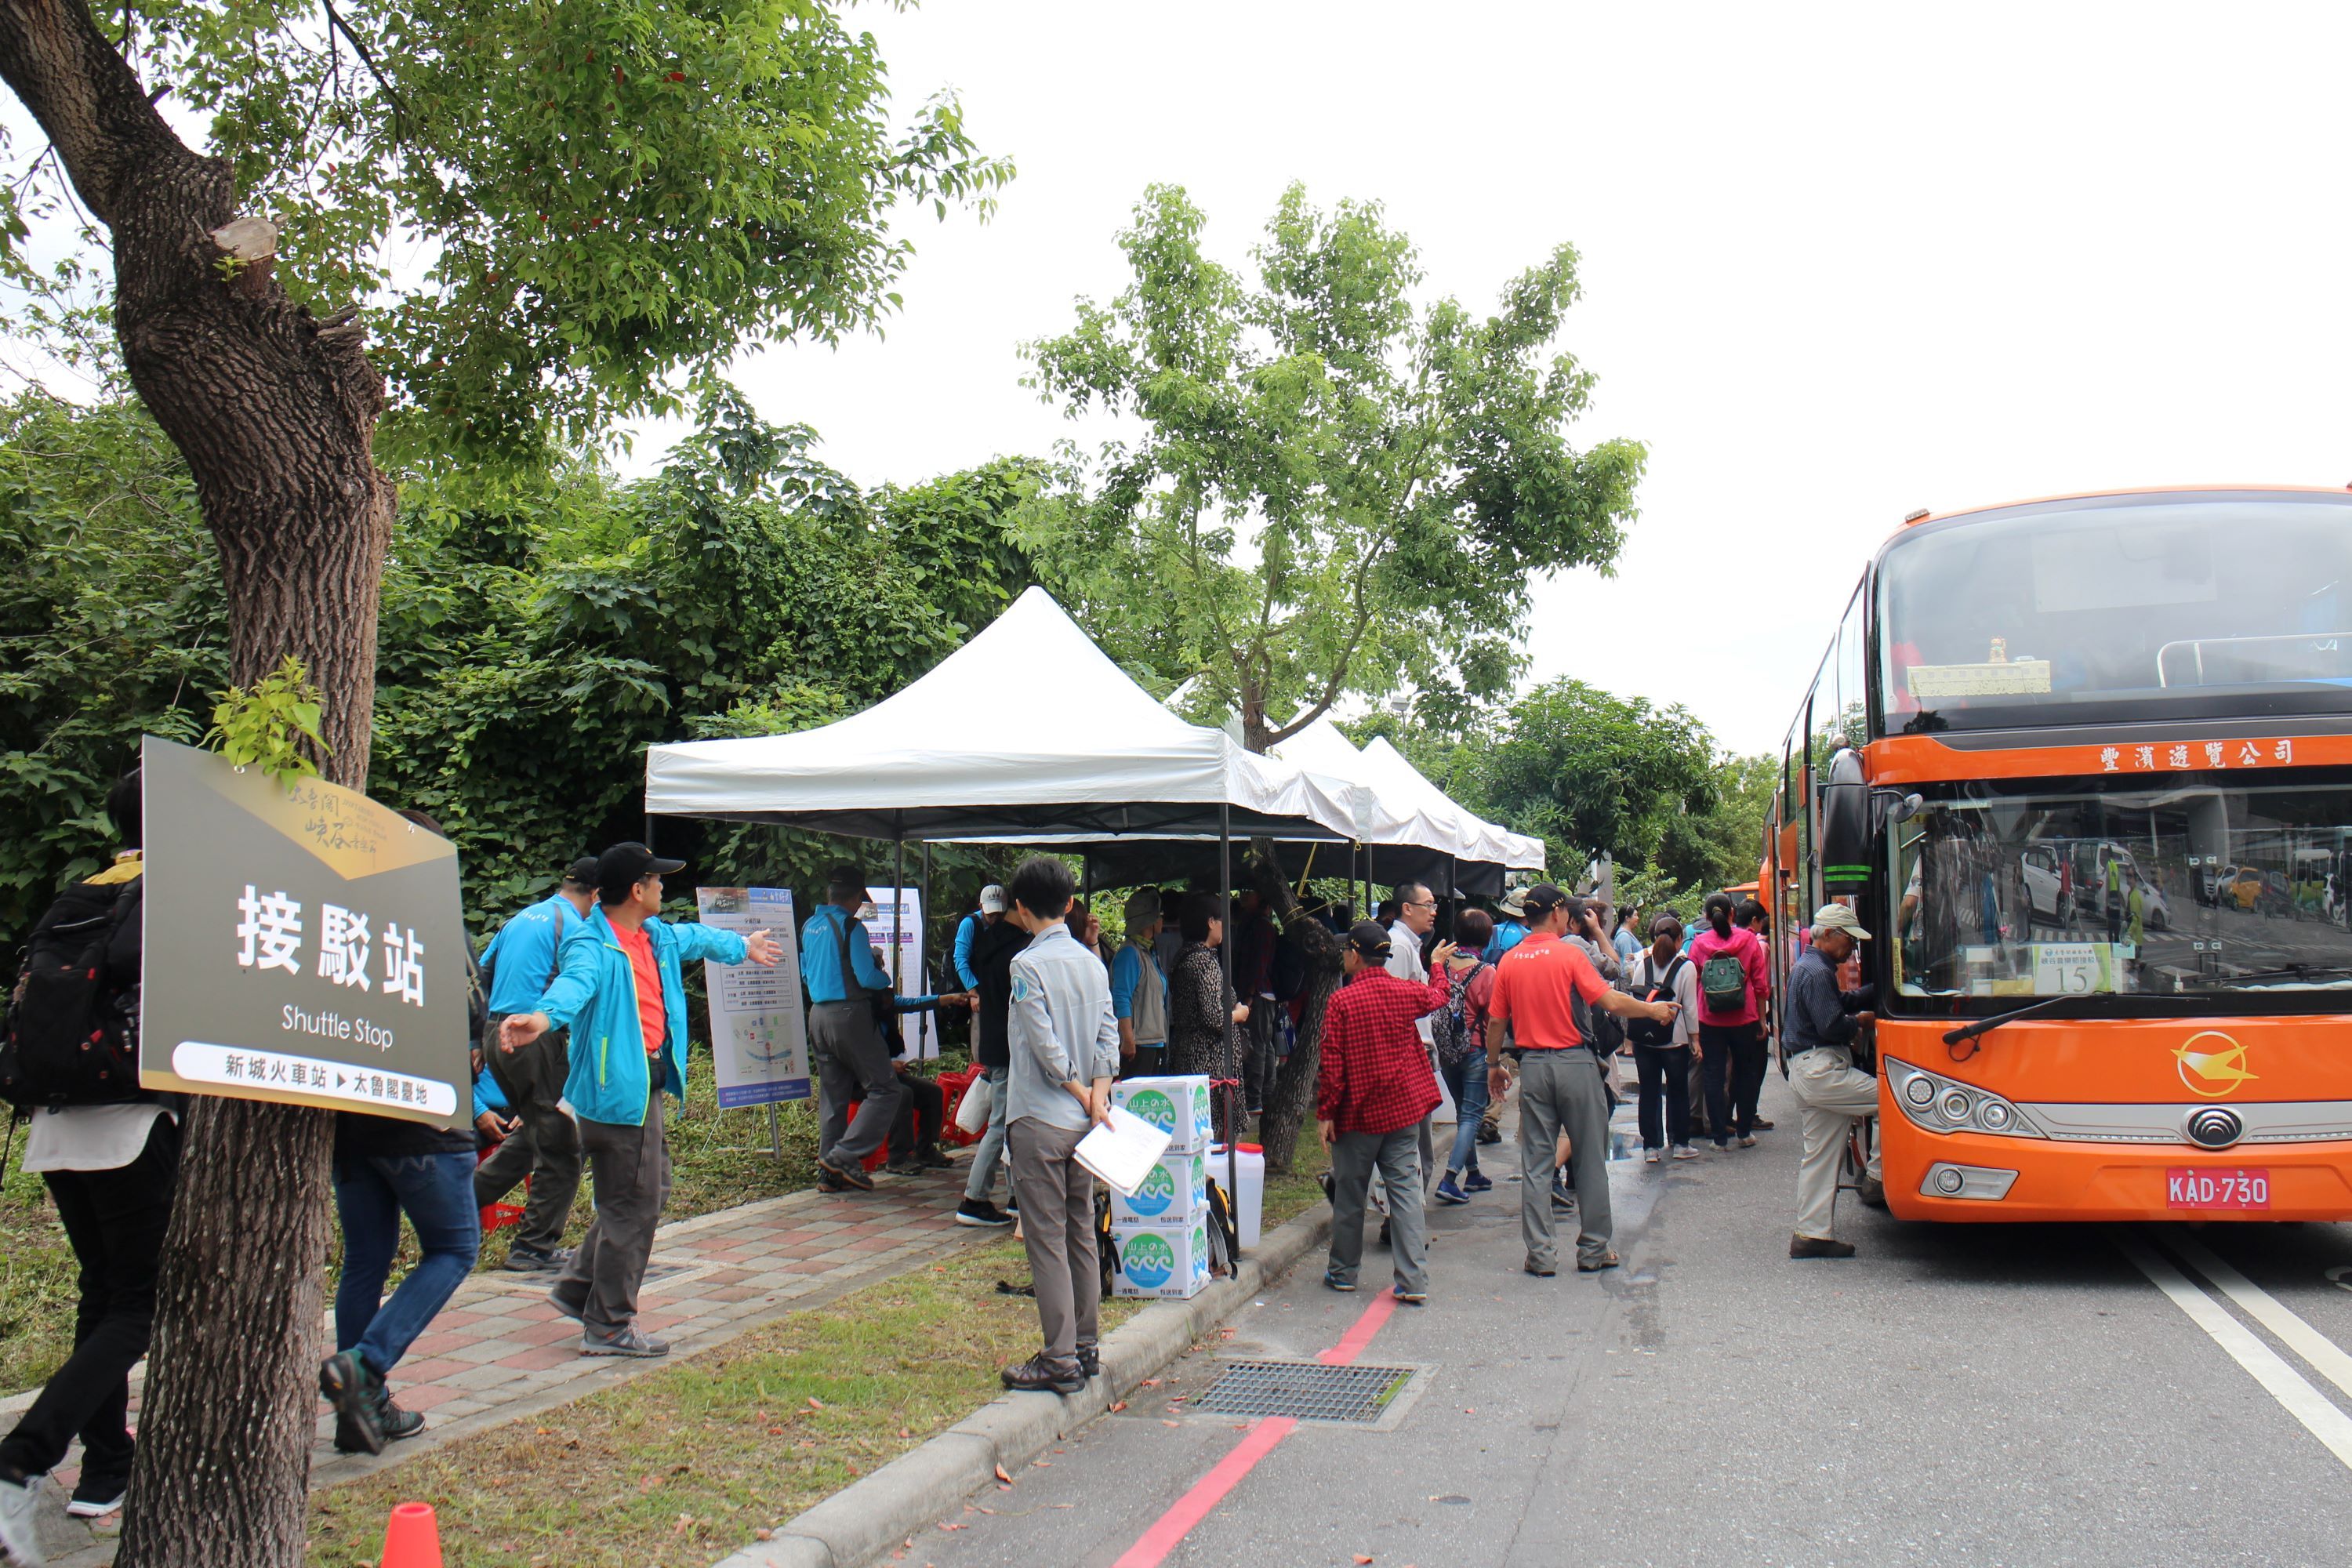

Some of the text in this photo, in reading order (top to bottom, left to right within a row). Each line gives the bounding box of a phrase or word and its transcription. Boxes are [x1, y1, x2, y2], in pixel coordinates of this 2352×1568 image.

[2100, 739, 2292, 771] 豐濱遊覽公司
[237, 884, 425, 1007] 接駁站
[2056, 966, 2087, 993] 15
[282, 1004, 394, 1051] Shuttle Stop
[226, 1054, 428, 1105] 新城火車站 太魯閣臺地
[1129, 1098, 1170, 1108] 山上の水
[1127, 1242, 1168, 1251] 山上の水
